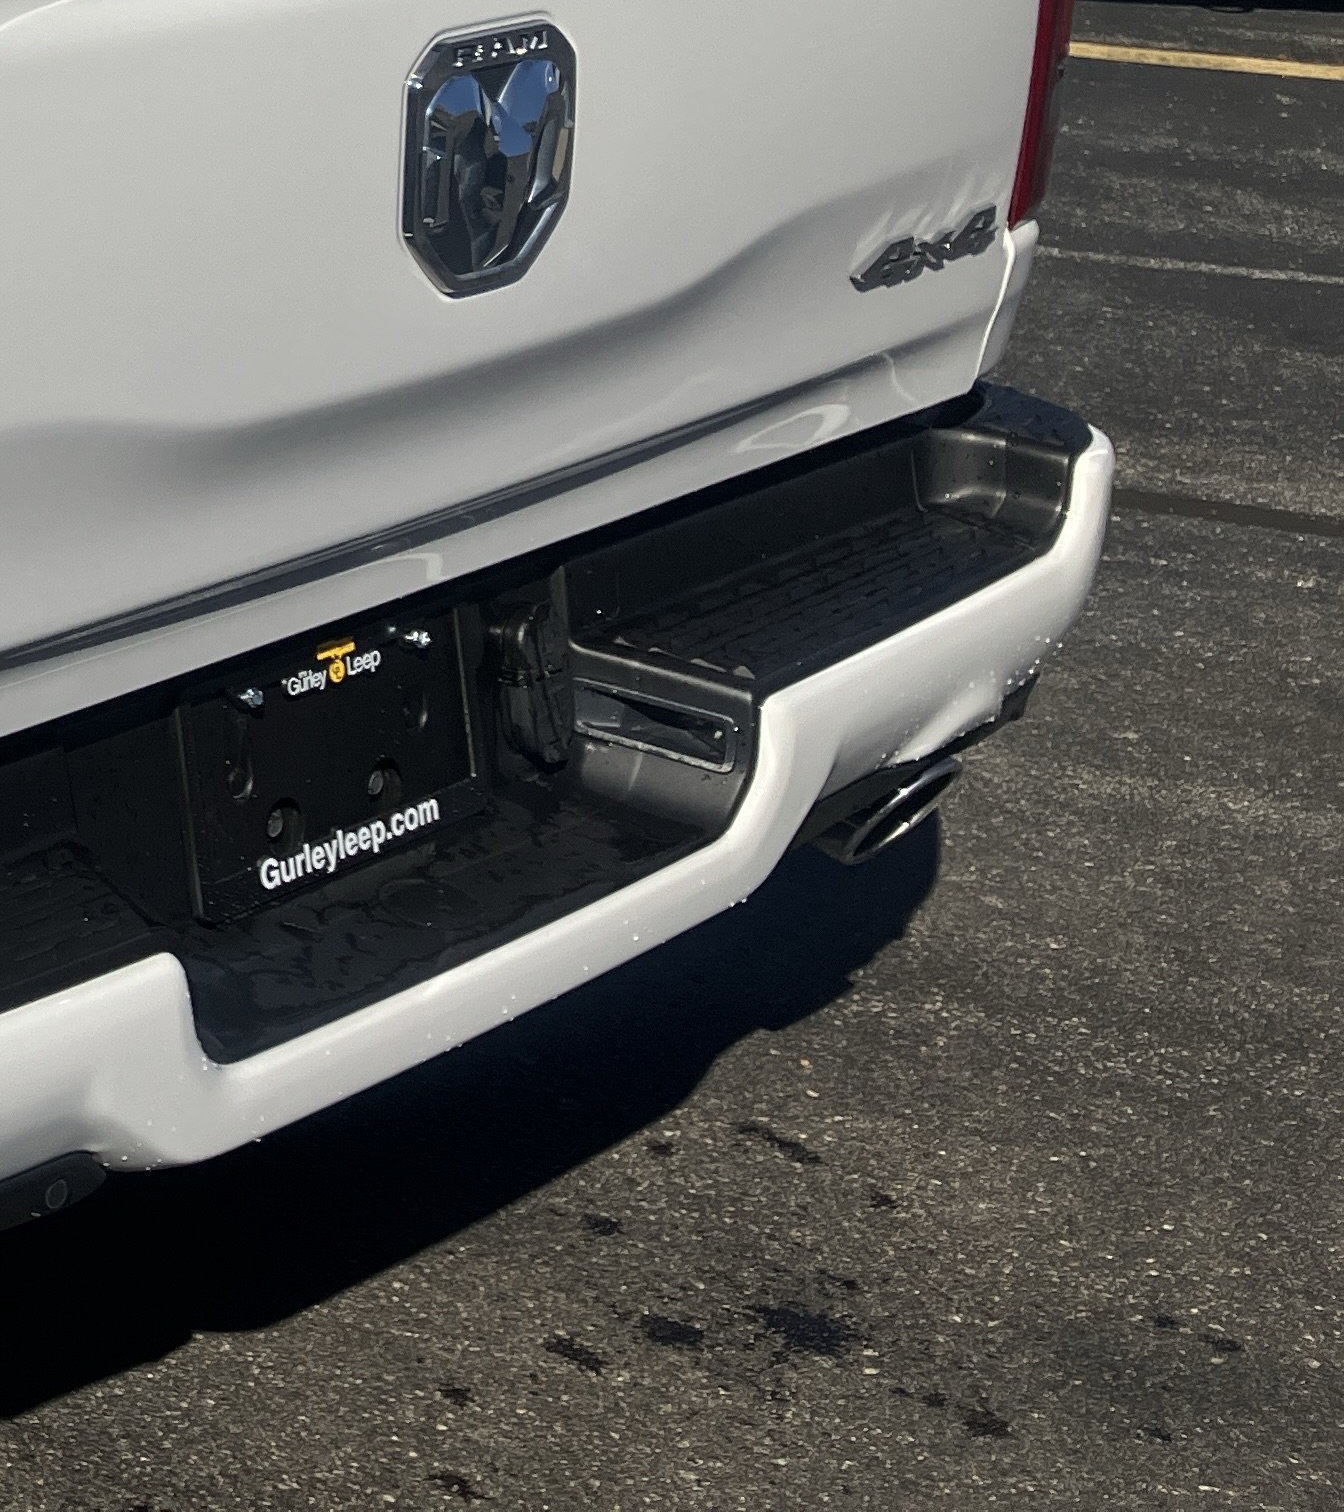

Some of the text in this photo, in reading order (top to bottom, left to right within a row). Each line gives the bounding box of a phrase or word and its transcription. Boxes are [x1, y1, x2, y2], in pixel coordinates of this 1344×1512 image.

[849, 204, 998, 294] 4x4
[287, 669, 327, 696] Gurley
[346, 650, 382, 676] Leep
[261, 798, 441, 890] Gurleyleep.com
